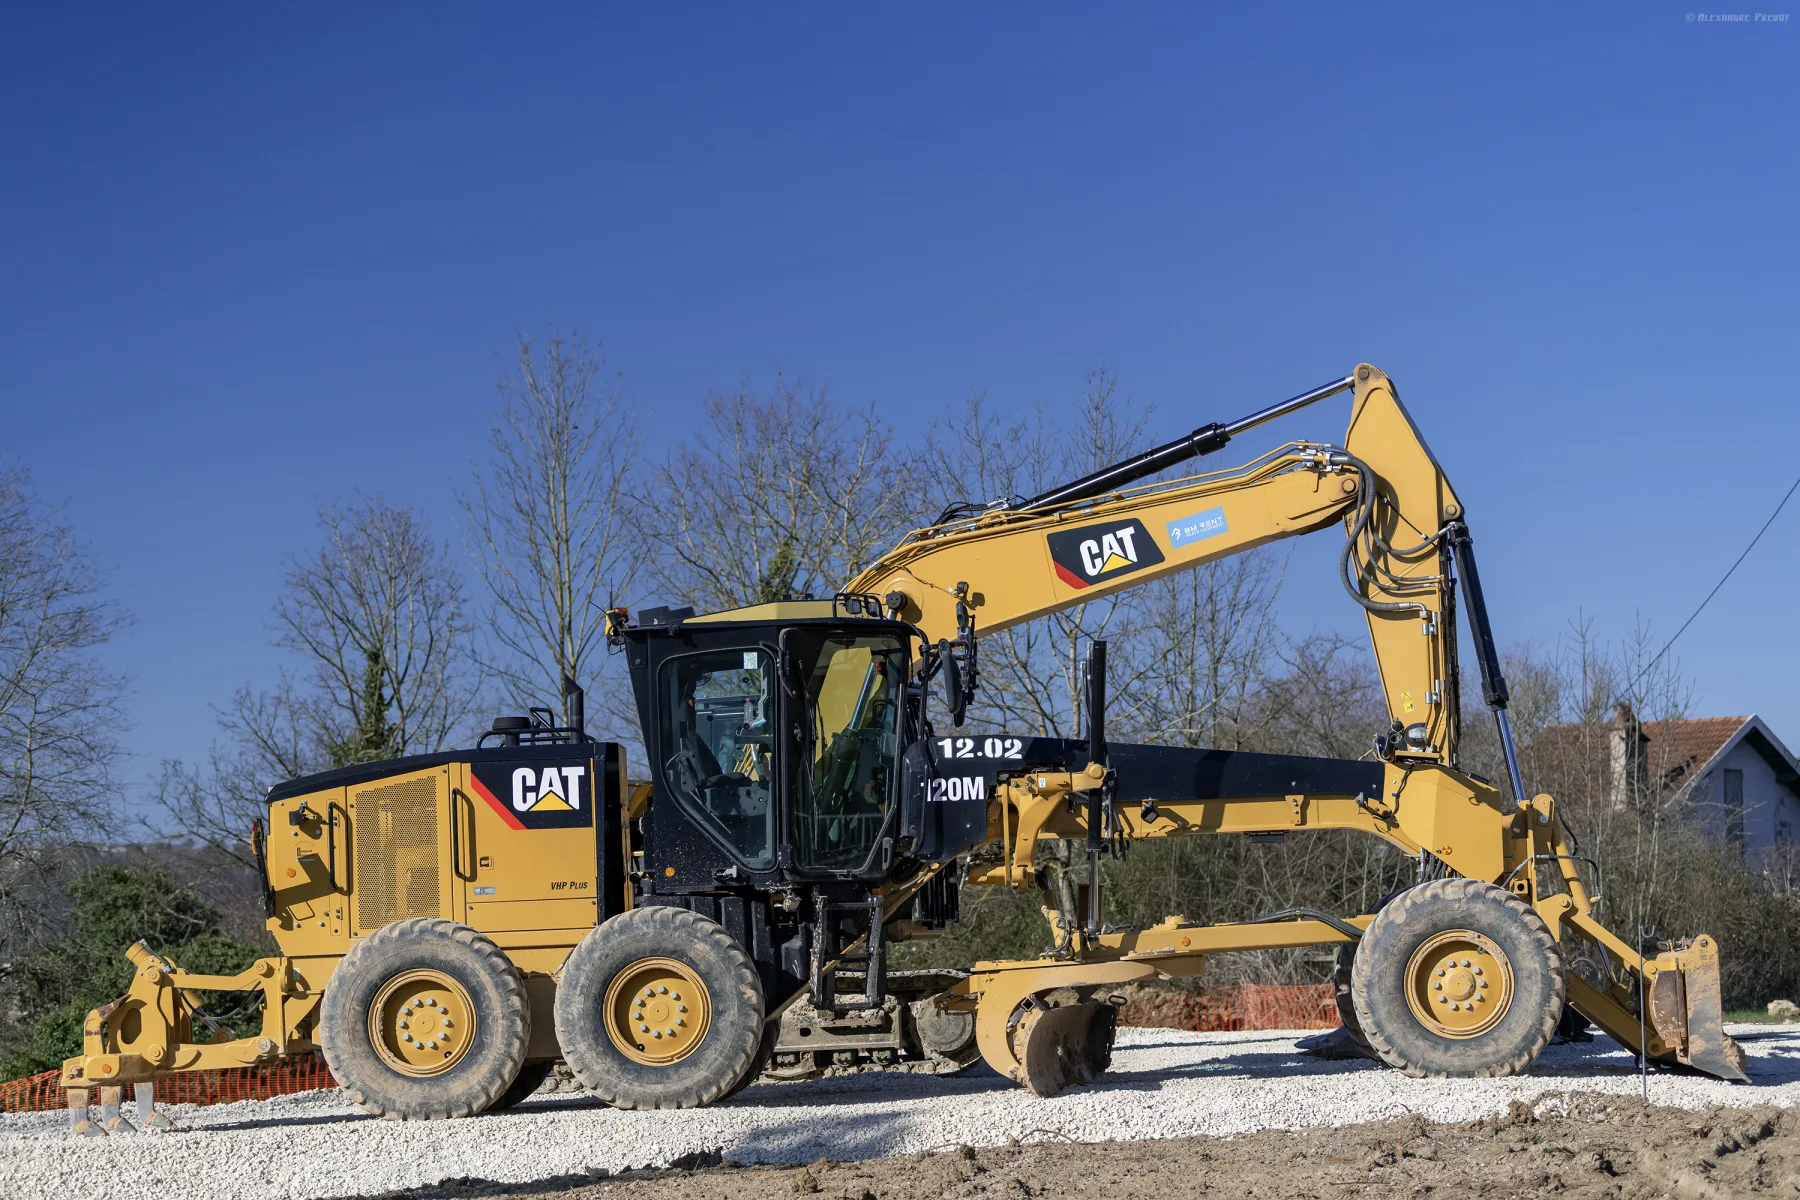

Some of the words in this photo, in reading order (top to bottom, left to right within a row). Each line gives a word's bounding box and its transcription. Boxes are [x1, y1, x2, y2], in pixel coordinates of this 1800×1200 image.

[1184, 525, 1198, 534] BM
[1199, 516, 1223, 528] RENT
[1079, 526, 1138, 577] CAT
[937, 738, 1022, 759] 12.02
[512, 766, 585, 812] CAT
[551, 881, 568, 890] VHP
